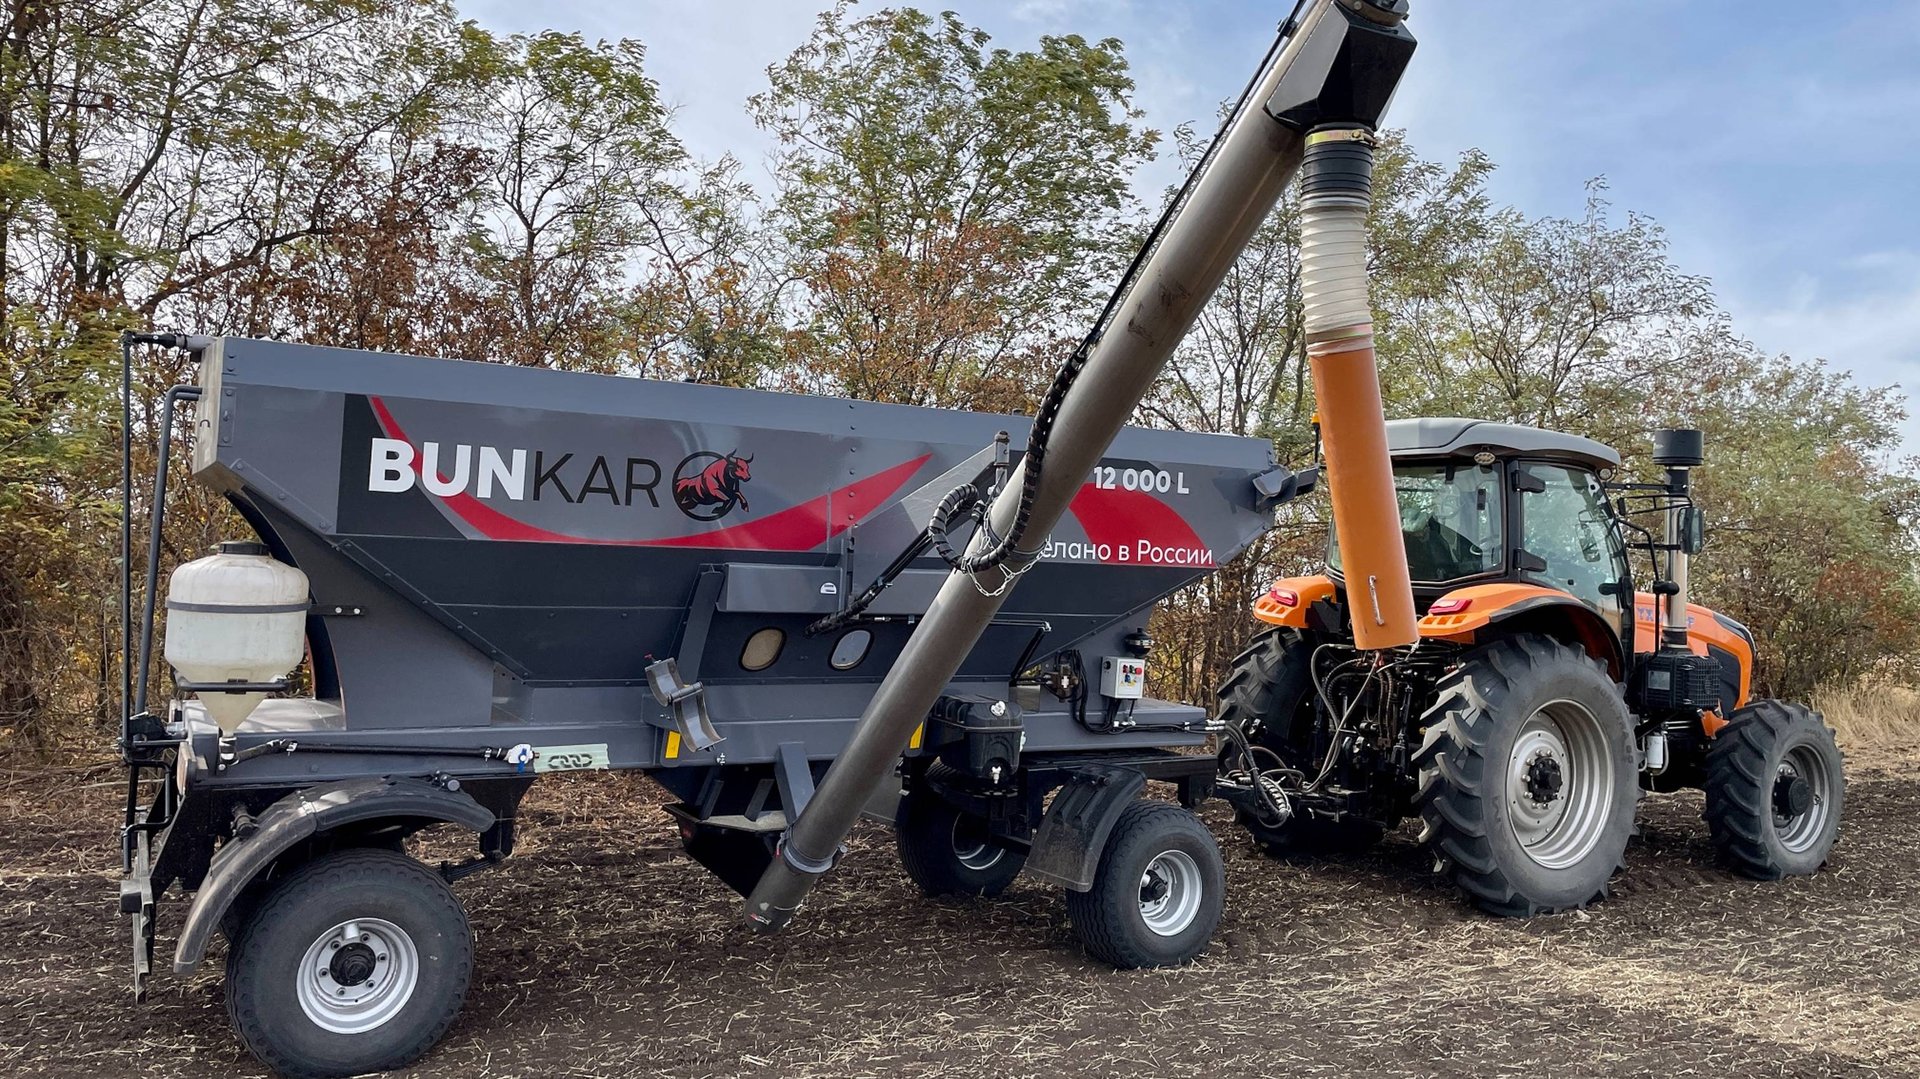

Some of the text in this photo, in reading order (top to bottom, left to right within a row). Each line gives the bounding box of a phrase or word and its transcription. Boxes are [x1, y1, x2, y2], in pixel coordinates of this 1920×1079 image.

[368, 437, 662, 508] BUNKAR
[1093, 466, 1190, 494] 12 000 L
[1041, 540, 1212, 565] елано в России
